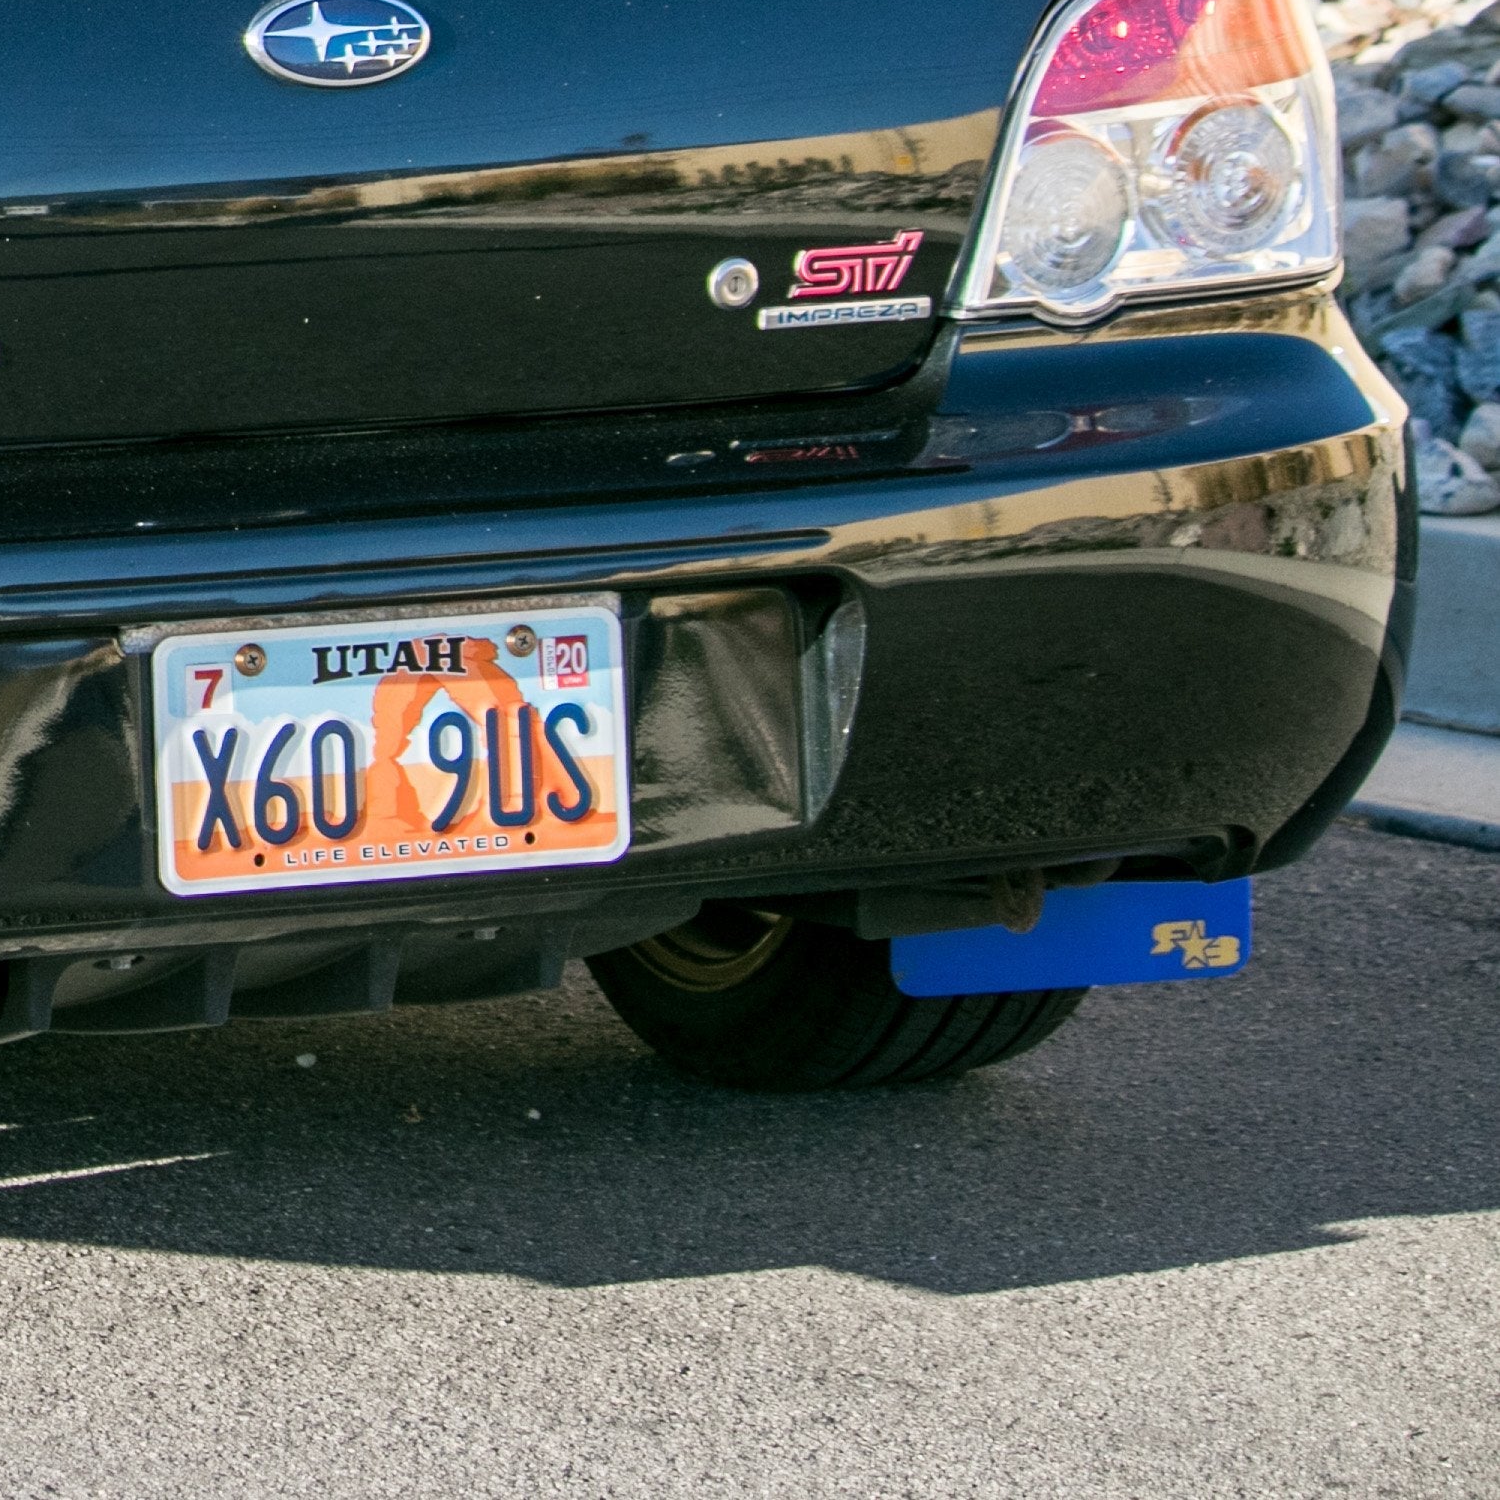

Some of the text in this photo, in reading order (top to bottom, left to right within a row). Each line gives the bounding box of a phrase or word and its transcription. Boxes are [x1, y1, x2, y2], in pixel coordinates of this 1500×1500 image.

[776, 301, 920, 325] IMPREZA
[312, 636, 467, 685] UTAH
[556, 642, 588, 675] 20
[193, 668, 223, 709] 7
[193, 702, 592, 851] X60 9US
[286, 833, 510, 866] LIFE ELEVATED
